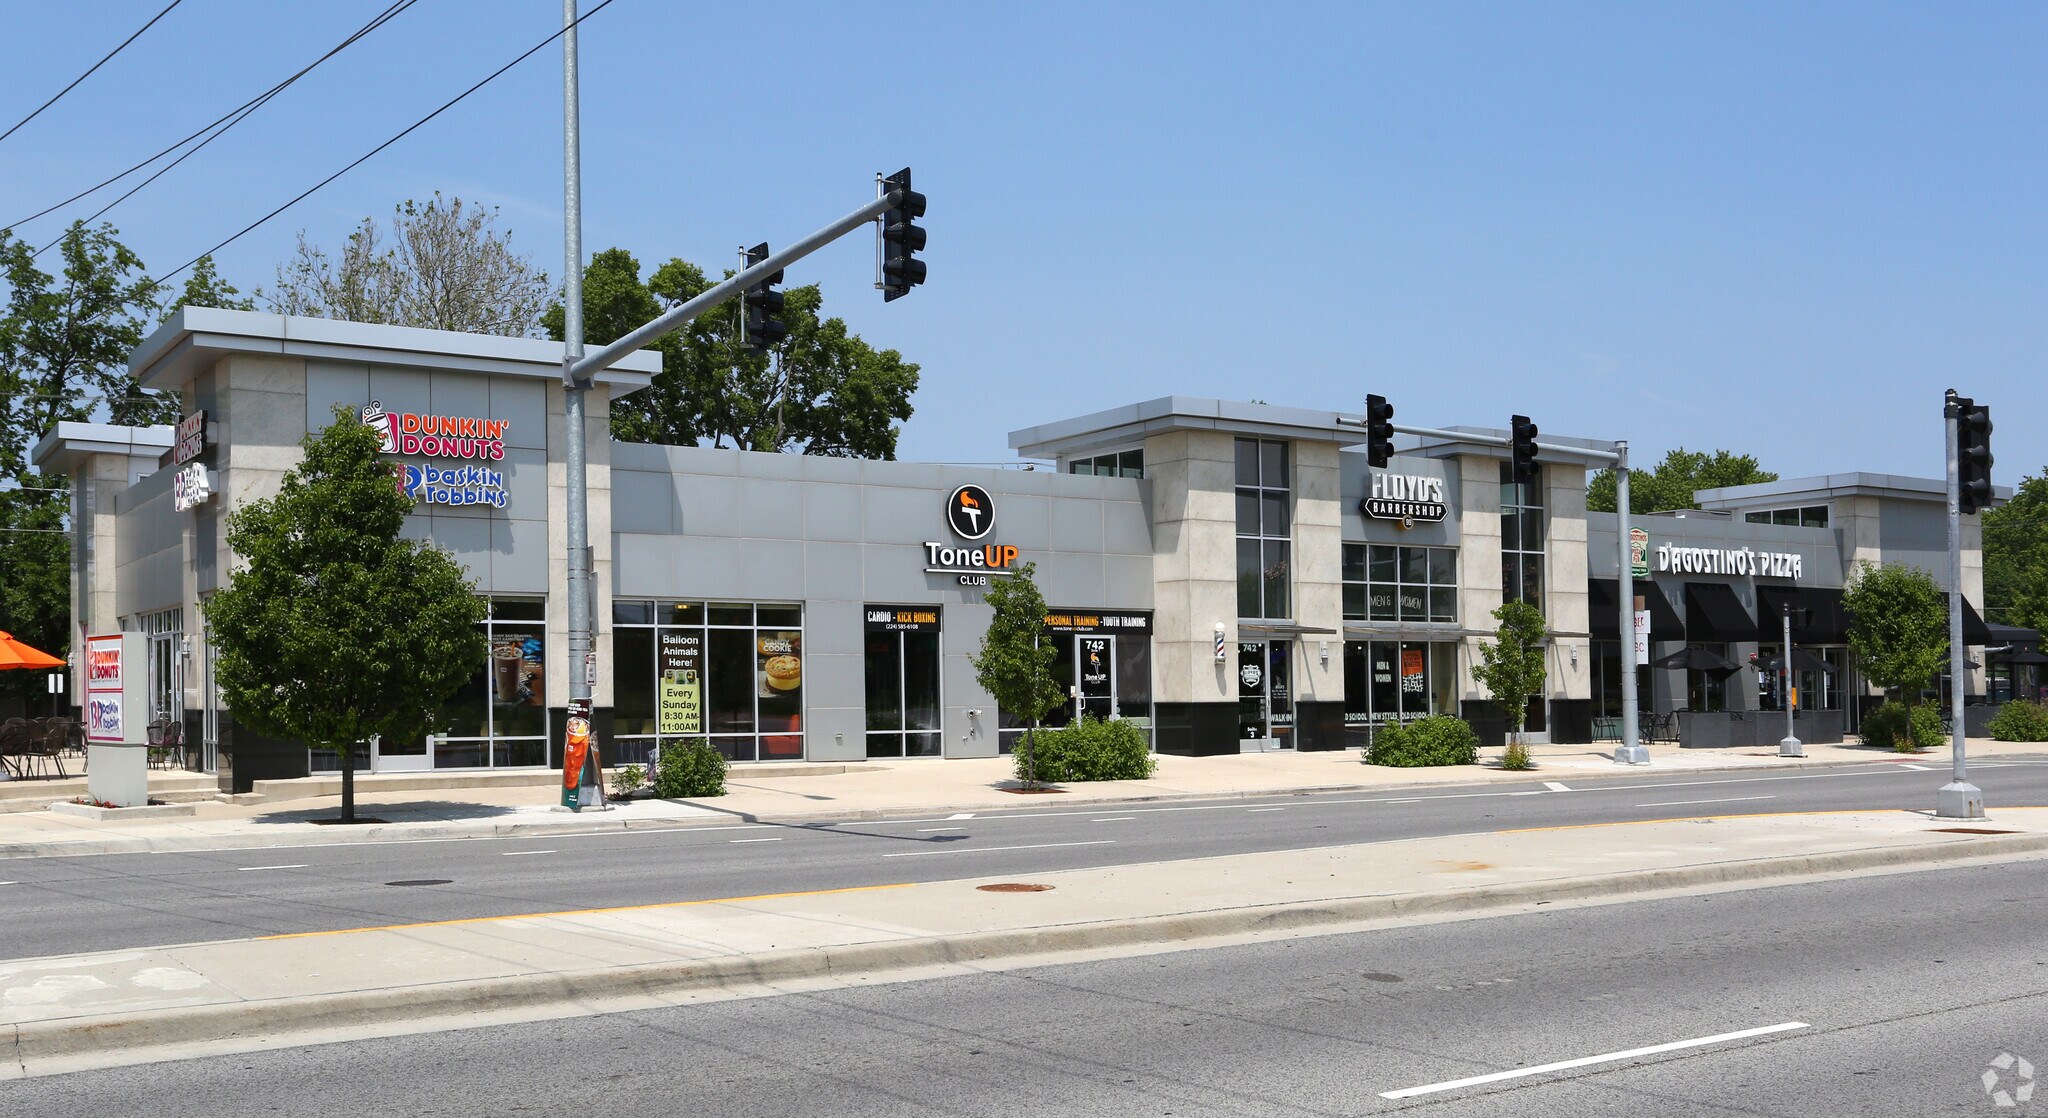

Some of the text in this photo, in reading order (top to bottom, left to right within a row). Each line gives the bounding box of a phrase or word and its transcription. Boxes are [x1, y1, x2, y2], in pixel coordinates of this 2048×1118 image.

[402, 413, 509, 439] DUNKIN'
[402, 435, 505, 460] DONUTS
[423, 464, 503, 488] baskin
[1371, 473, 1443, 502] FLOYD'S
[425, 485, 507, 508] robbins
[1373, 502, 1442, 516] BARBERSHOP
[924, 542, 1019, 568] ToneUP
[1658, 542, 1802, 580] D'AGOSTINO'S PIZZA
[959, 575, 987, 586] CLUB
[1370, 595, 1386, 607] MEN
[867, 611, 892, 622] CARDIO
[897, 612, 912, 623] KICK
[913, 612, 936, 623] BOXING
[1043, 615, 1072, 626] PERSONAL
[1073, 615, 1099, 626] TRAINING
[1121, 617, 1146, 627] TRAINING
[662, 635, 699, 645] Balloon
[1085, 640, 1105, 650] 742
[663, 647, 698, 656] Animals
[763, 645, 792, 653] COOKIE
[1243, 644, 1257, 652] 742
[668, 658, 693, 667] Here!
[97, 665, 119, 679] DONUTS
[1374, 674, 1392, 683] WOMEN
[666, 689, 693, 699] Every
[662, 700, 697, 711] Sunday
[664, 712, 683, 720] 8:30
[1349, 713, 1367, 721] SCHOOL
[661, 723, 698, 731] 11:00AM
